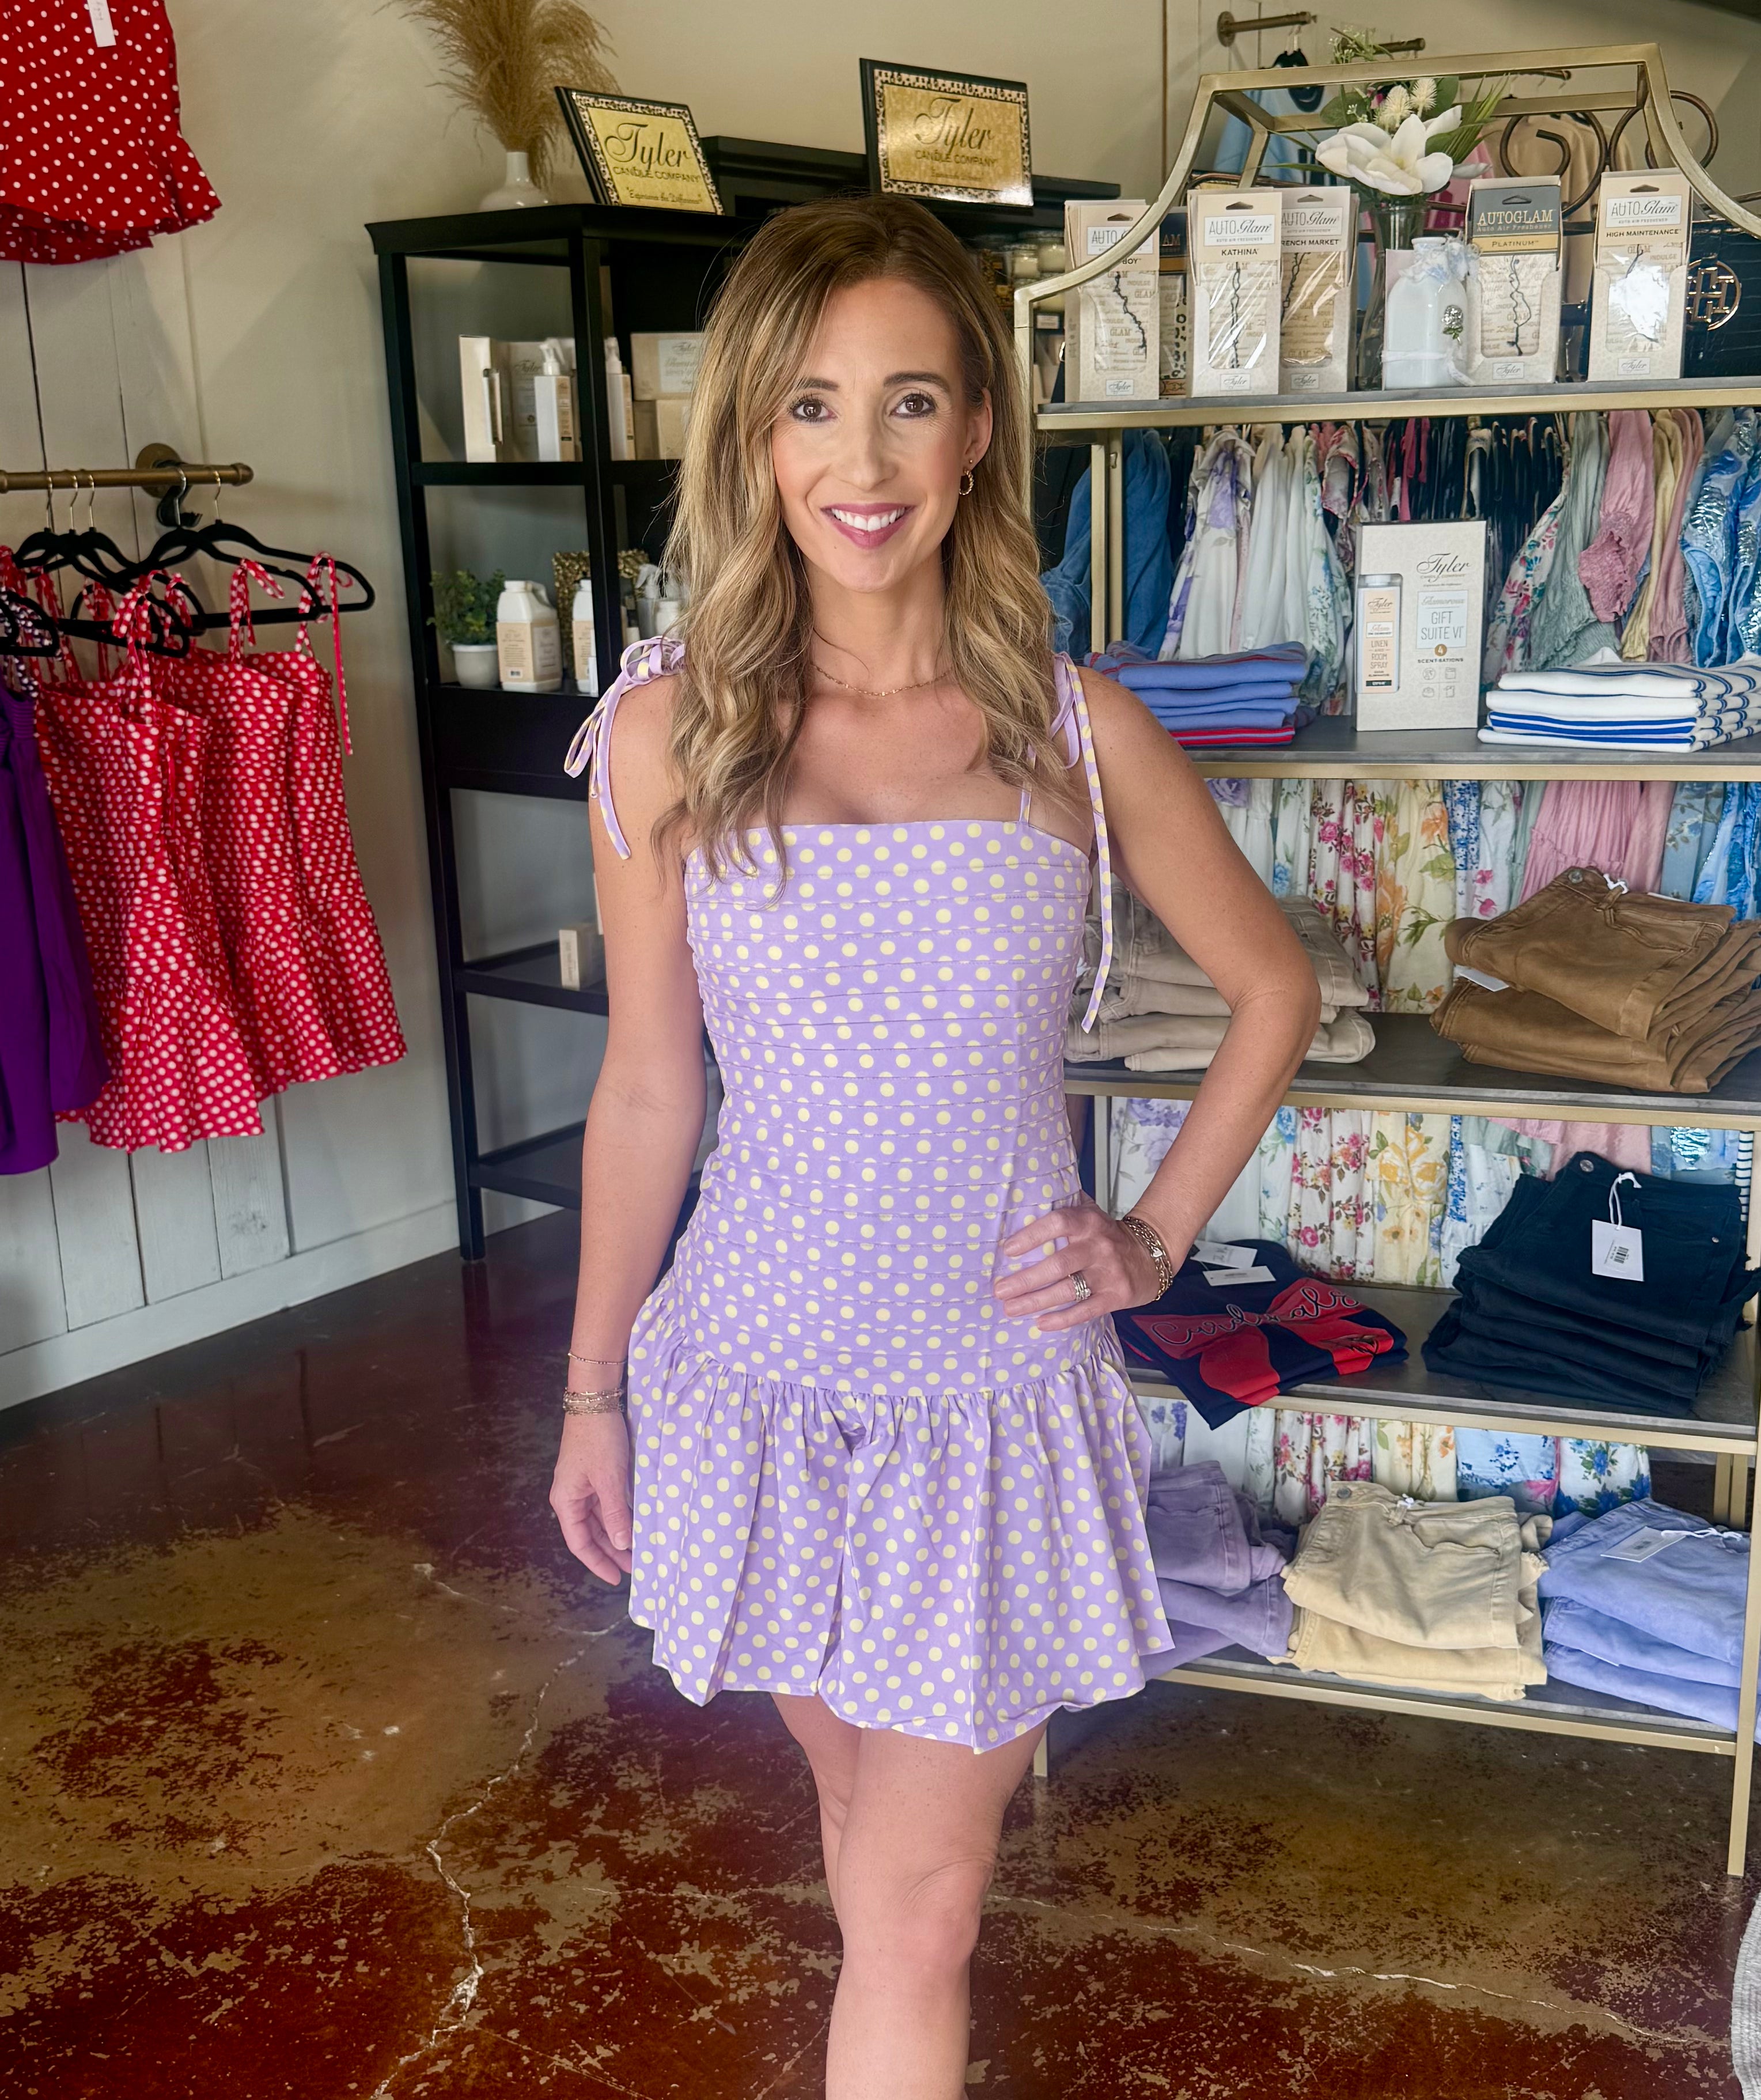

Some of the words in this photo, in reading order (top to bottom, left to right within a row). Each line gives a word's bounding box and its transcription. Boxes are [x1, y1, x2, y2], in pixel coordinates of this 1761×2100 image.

[914, 97, 995, 156] Tyler
[604, 122, 692, 175] Tyler
[915, 150, 951, 162] CANDLE
[954, 154, 998, 167] COMPANY
[612, 167, 654, 179] CANDLE
[655, 171, 700, 183] COMPANY
[1611, 202, 1640, 216] AUTO
[1641, 200, 1675, 215] Glam
[1281, 212, 1306, 226] AUTO
[1307, 211, 1337, 225] Glam
[1477, 209, 1553, 226] AUTOGLAM
[1209, 220, 1236, 235] AUTO
[1237, 220, 1270, 234] Glam
[1092, 230, 1118, 244] AUTO
[1496, 364, 1521, 377] Tyler
[1622, 360, 1648, 372] Tyler
[1109, 380, 1131, 394] Tyler
[1224, 376, 1248, 389] Tyler
[1294, 375, 1316, 387] Tyler
[1416, 553, 1471, 582] Tyler
[1368, 597, 1393, 612] Tyler
[1431, 611, 1453, 624] GIFT
[1421, 626, 1451, 640] SUITE
